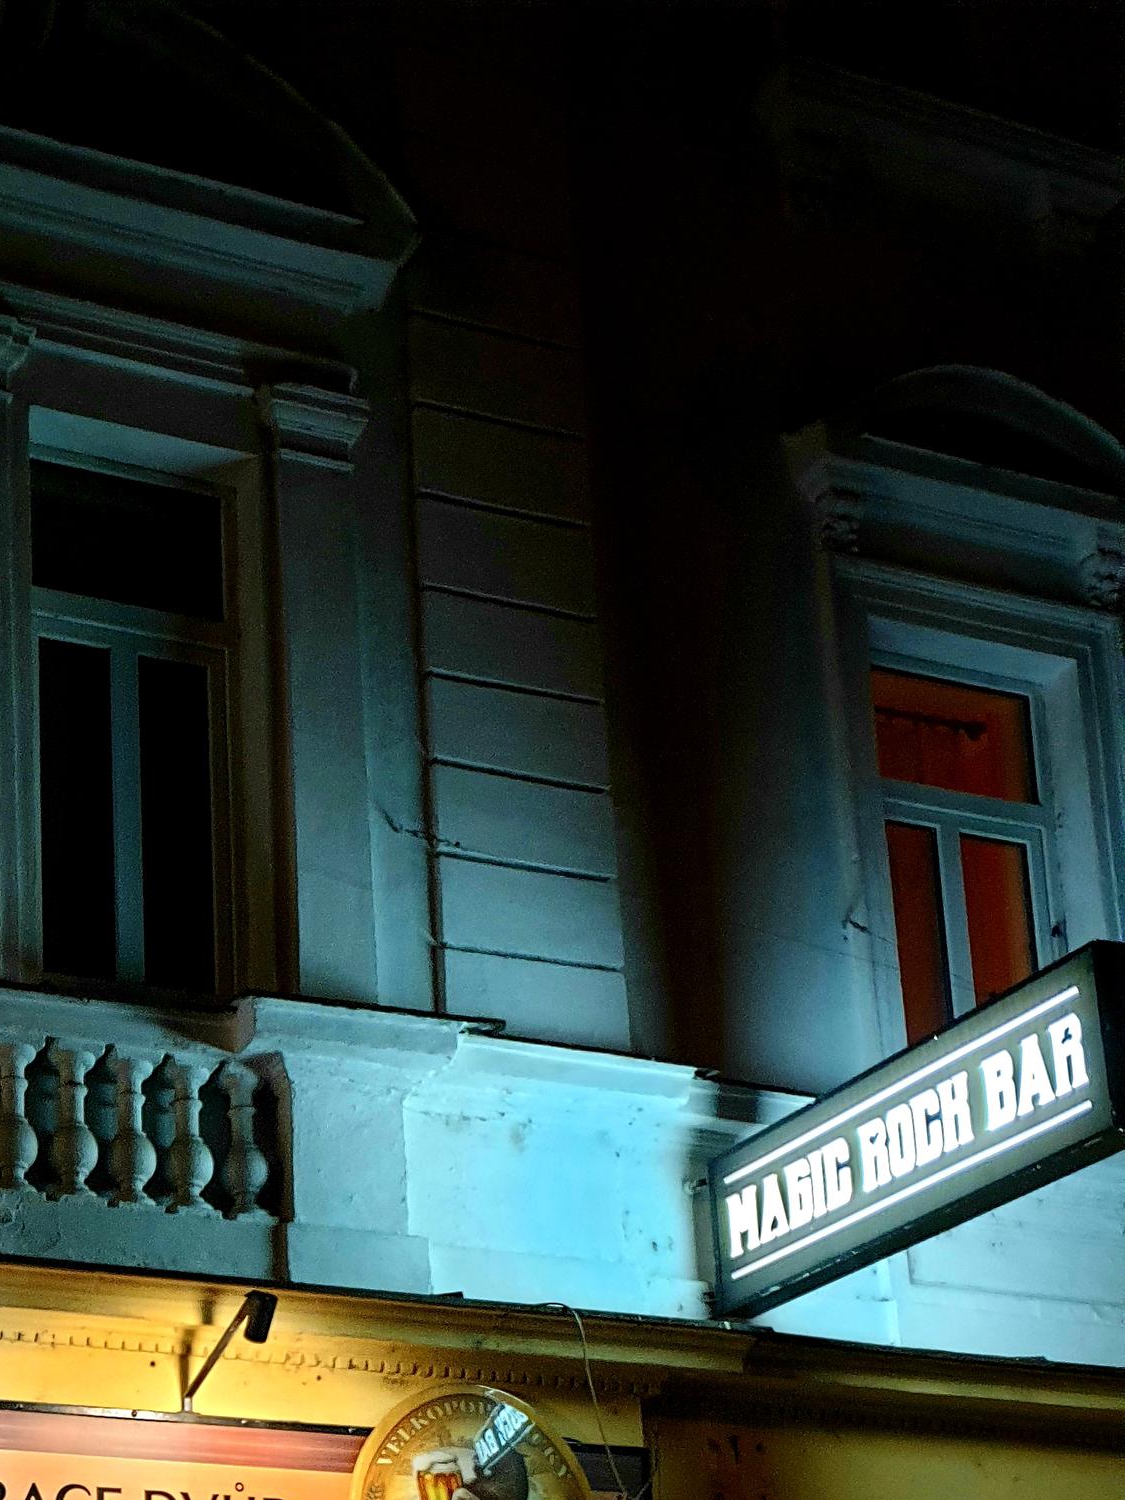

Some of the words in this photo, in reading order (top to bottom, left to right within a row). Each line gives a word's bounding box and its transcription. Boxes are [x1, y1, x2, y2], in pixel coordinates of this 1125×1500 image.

[726, 1137, 852, 1259] MAGIC
[857, 1070, 974, 1192] ROCK
[980, 1012, 1089, 1131] BAR
